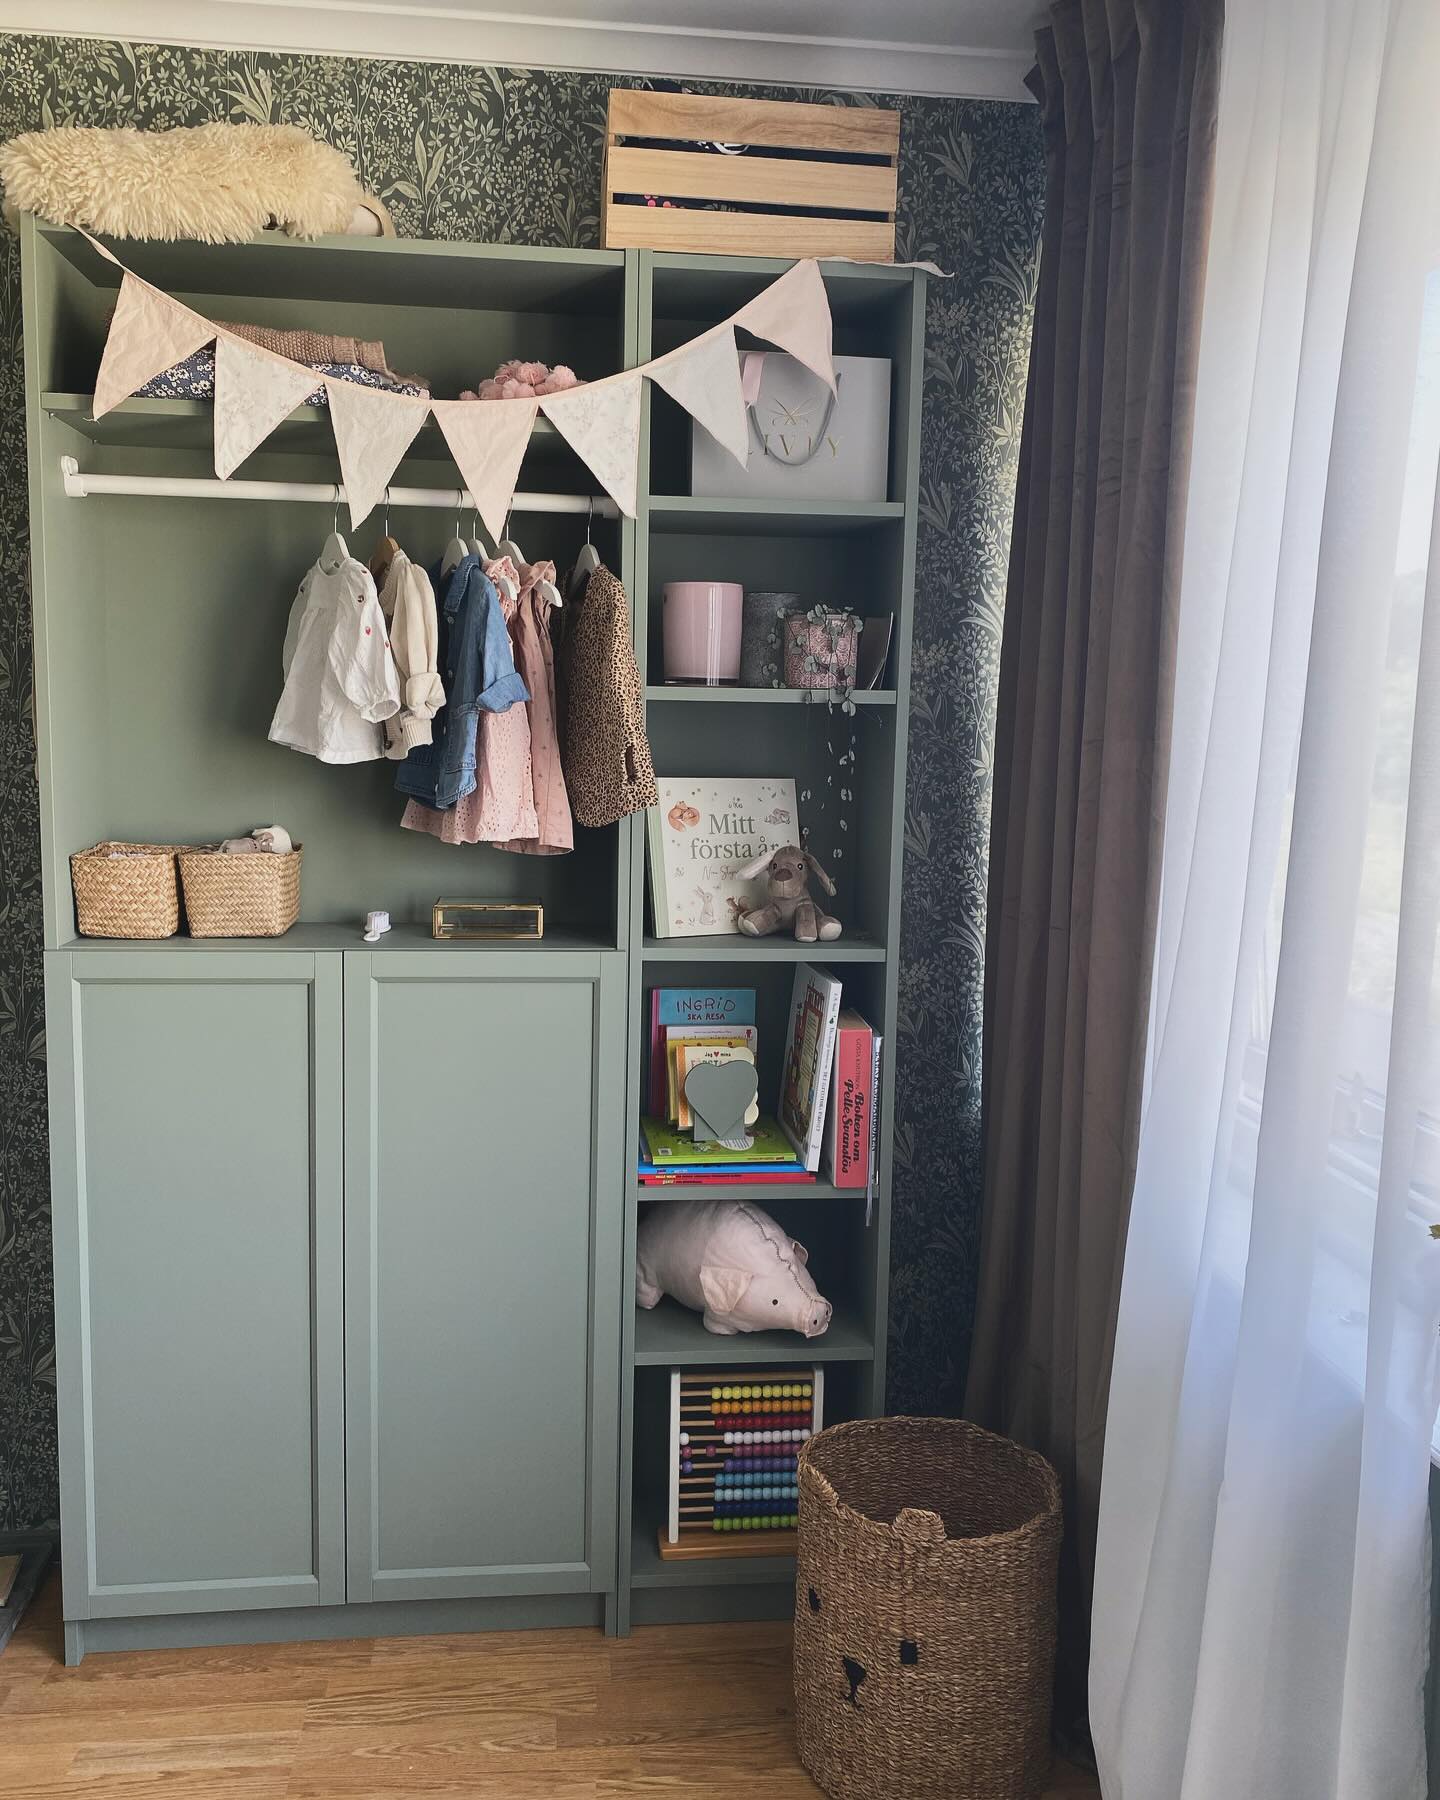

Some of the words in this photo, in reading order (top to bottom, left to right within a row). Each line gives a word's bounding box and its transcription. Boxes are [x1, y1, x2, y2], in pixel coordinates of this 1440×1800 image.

[748, 434, 842, 457] IVLY
[709, 813, 755, 835] Mitt
[690, 837, 753, 860] första
[687, 1012, 702, 1020] SKA
[705, 1012, 725, 1020] RESA
[843, 1079, 854, 1114] Pelle
[853, 1092, 865, 1138] Boken
[841, 1115, 853, 1174] Svanslös
[852, 1141, 861, 1162] om
